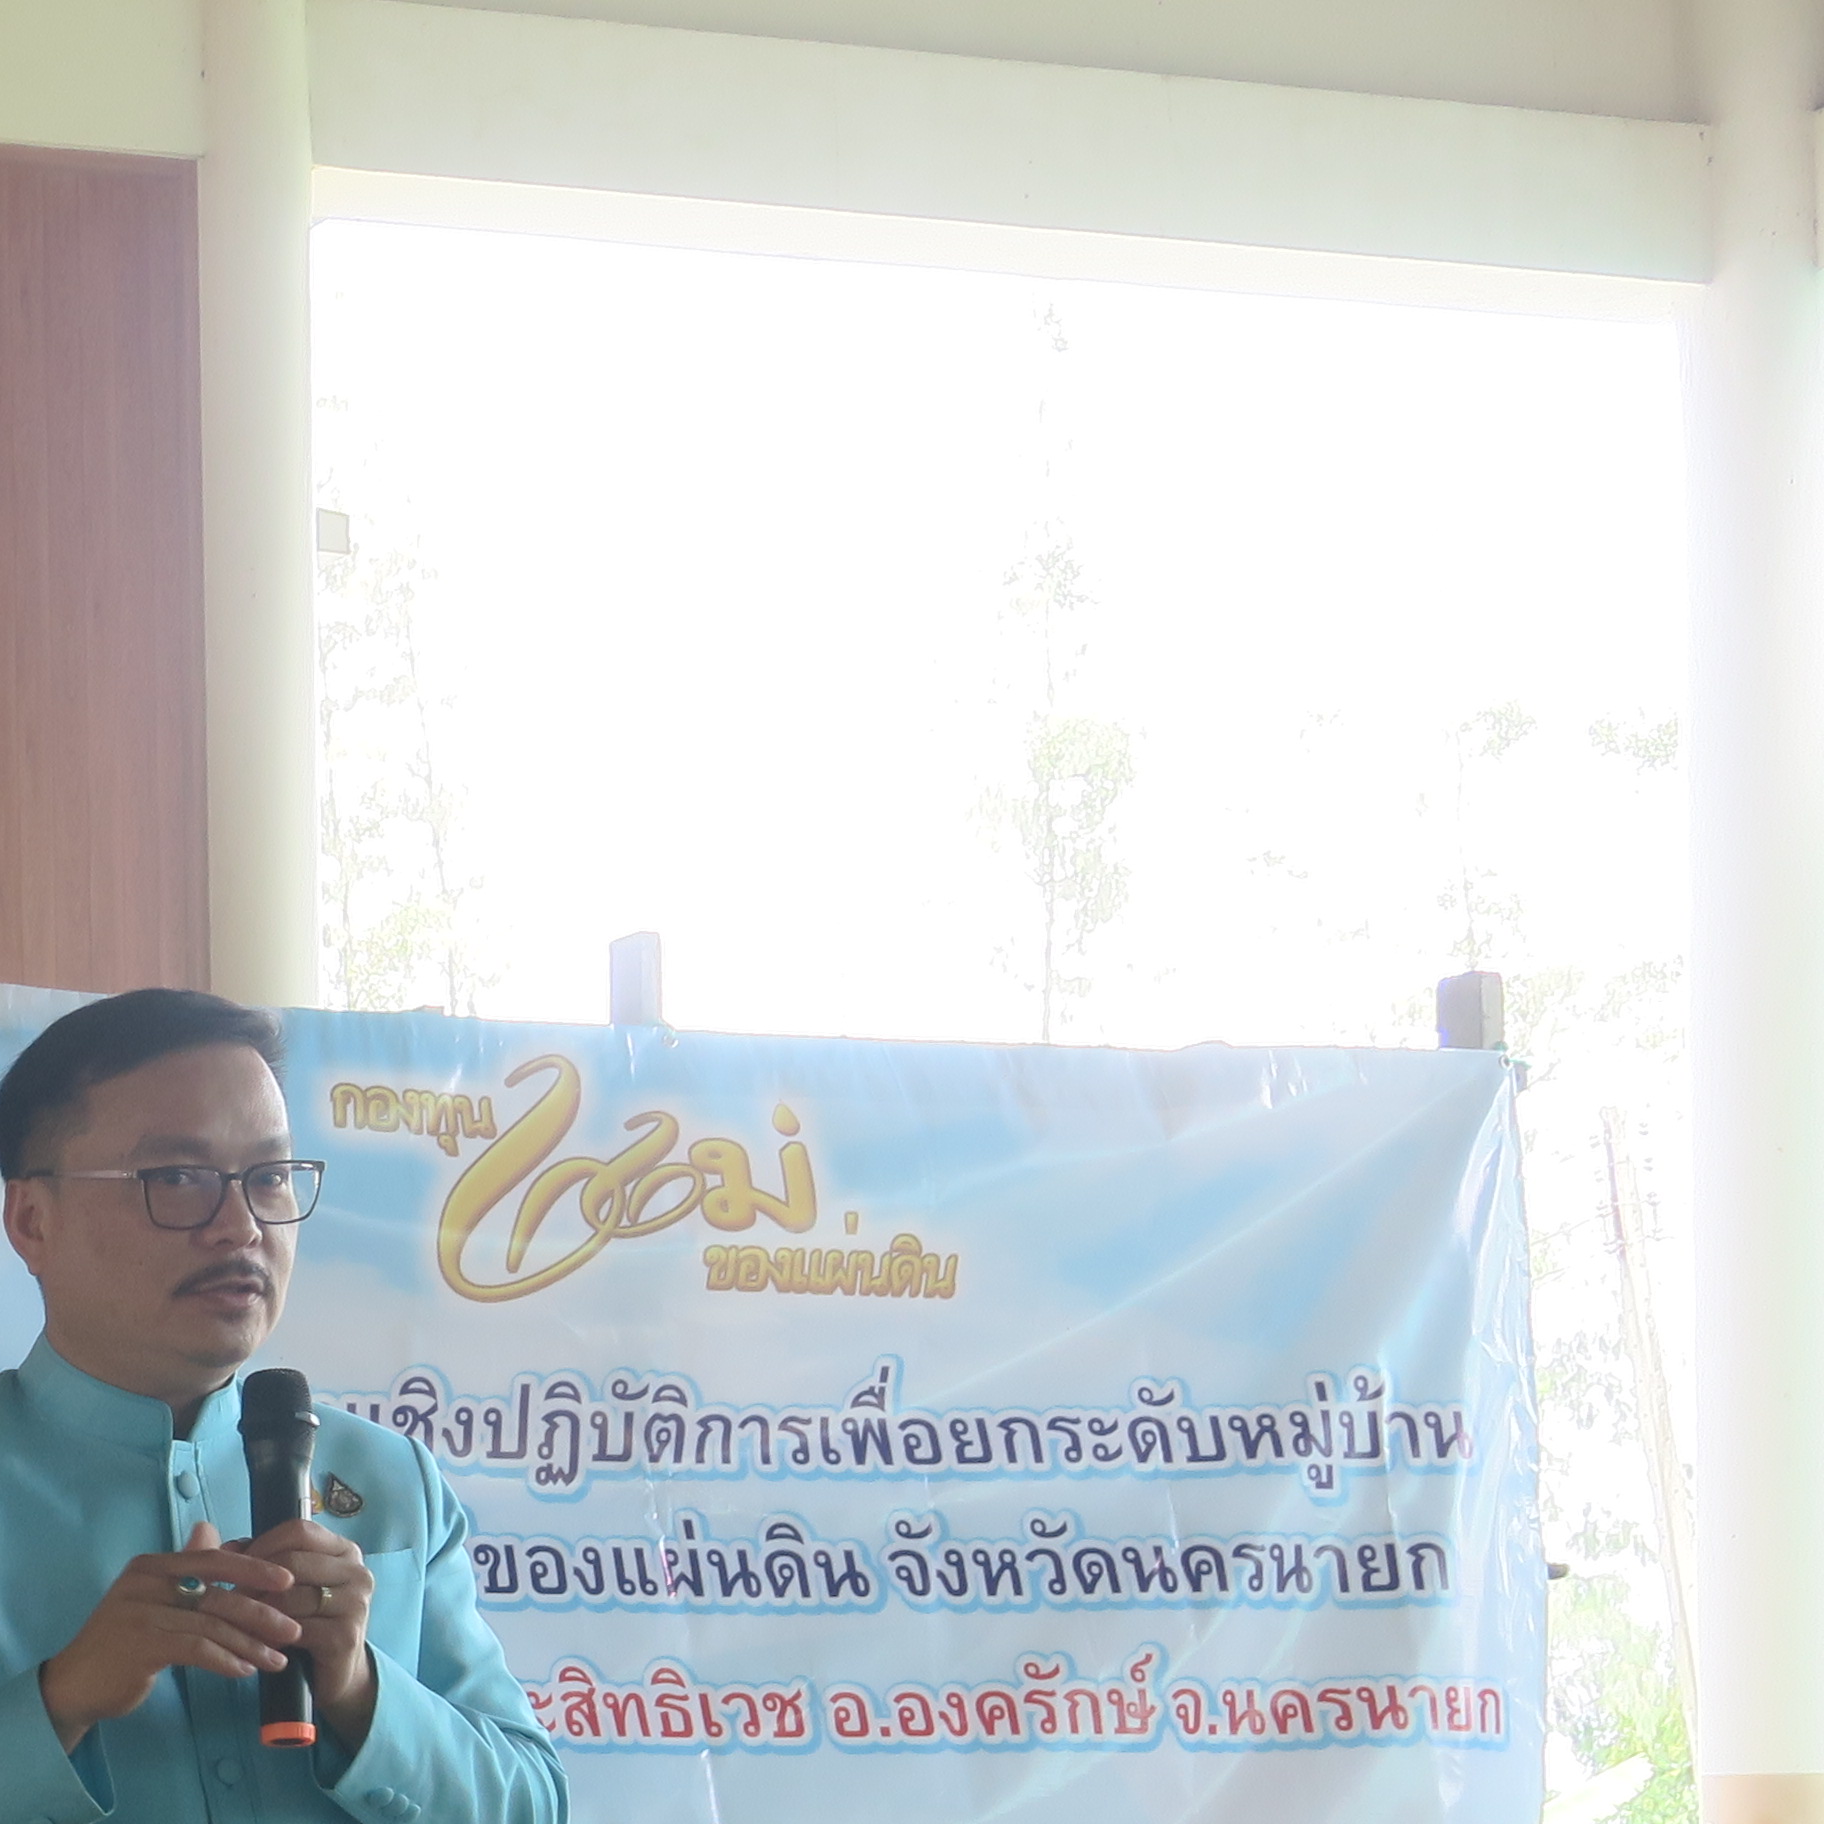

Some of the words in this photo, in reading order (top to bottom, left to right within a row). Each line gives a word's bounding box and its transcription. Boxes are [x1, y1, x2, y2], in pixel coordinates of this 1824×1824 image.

[330, 1082, 497, 1156] กองทุน
[703, 1212, 958, 1299] ของแผ่นดิน
[345, 1365, 1473, 1490] ชิงปฏิบัติการเพื่อยกระดับหมู่บ้าน
[475, 1511, 870, 1600] ของแผ่นดิน
[894, 1517, 1449, 1597] จังหวัดนครนายก
[833, 1651, 1156, 1740] อ.องครักษ์
[1172, 1683, 1503, 1735] จ.นครนายก
